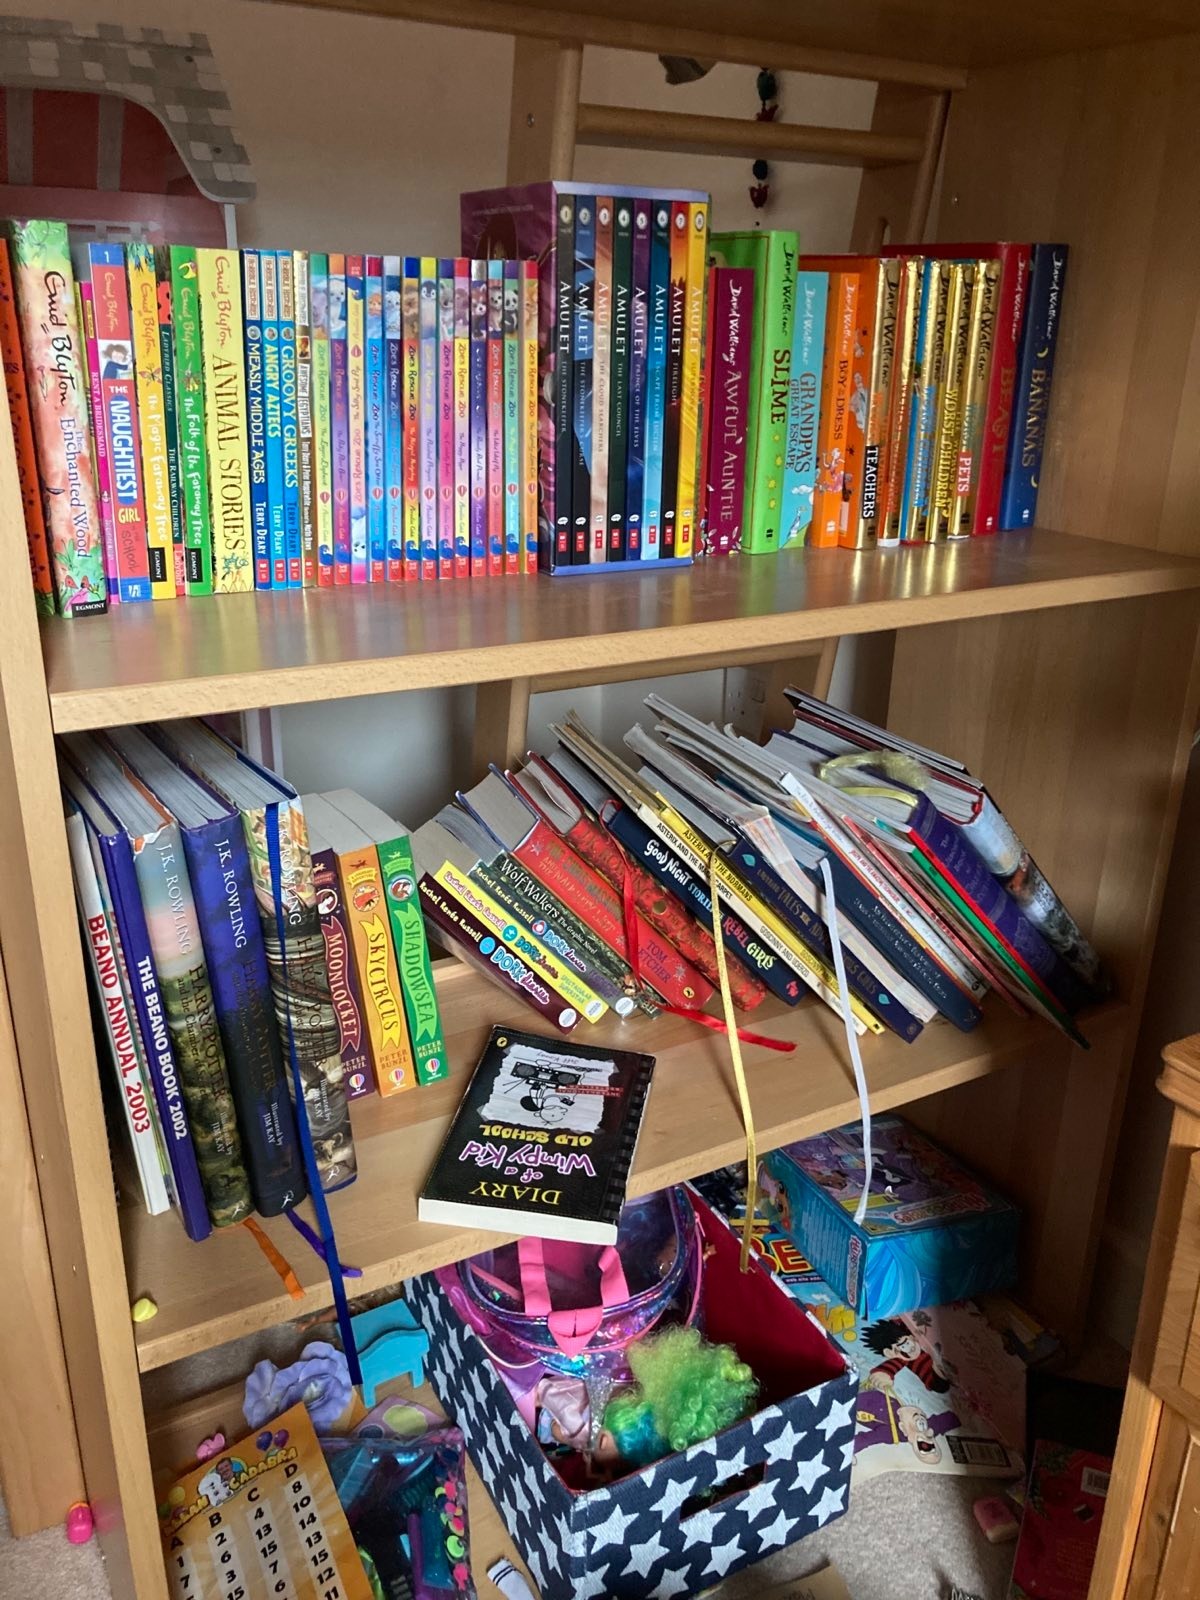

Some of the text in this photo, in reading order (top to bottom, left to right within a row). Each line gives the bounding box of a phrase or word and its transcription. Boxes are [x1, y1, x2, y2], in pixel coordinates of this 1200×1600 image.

[143, 317, 156, 356] Blyton
[216, 300, 232, 348] Blyton
[559, 281, 571, 354] AMULET
[577, 281, 589, 355] AMULET
[597, 282, 609, 354] AMULET
[615, 284, 628, 356] AMULET
[633, 286, 646, 357] AMULET
[653, 284, 666, 355] AMULET
[671, 286, 684, 356] AMULET
[689, 286, 702, 354] AMULET
[50, 334, 76, 406] Blyton
[108, 385, 128, 394] THE
[264, 344, 280, 438] ANGRY AZTECS
[91, 372, 106, 457] RENT BRIDESMAID
[248, 342, 264, 484] MEASLY MIDDLE AGES
[281, 345, 298, 489] GROOVY GREEKS
[298, 363, 311, 437] AWESOME EGYPTIANS
[785, 378, 801, 470] GREAT ESCAPE
[794, 372, 817, 474] GRANDPA'S
[833, 359, 849, 441] BOY DRESS
[942, 389, 957, 437] WORST
[1021, 367, 1047, 468] BANANAS
[110, 399, 137, 500] NAUGHTIEST
[187, 414, 201, 439] Folk
[212, 354, 246, 551] ANIMAL STORIES
[958, 455, 971, 493] PETS
[60, 417, 90, 558] Enchanted Wood
[148, 414, 168, 541] Magic Faraway Tree
[168, 447, 180, 539] THE RAILWAY CHILDREN
[863, 447, 878, 518] TEACHERS
[118, 508, 141, 524] GIRL
[191, 519, 205, 546] Tree
[255, 502, 267, 555] TERRY DEARY
[273, 505, 285, 555] TERRY DEARY
[287, 501, 299, 554] TERRY DEARY
[153, 551, 162, 578] EGMONT
[190, 552, 198, 578] EGMONT
[75, 602, 105, 612] EGMONT
[656, 822, 690, 854] ASTERIX AND
[278, 849, 302, 926] ROWLING
[681, 829, 754, 902] ASTERIX NORMANS
[155, 843, 194, 955] J.K. ROWLING
[214, 839, 247, 948] J.K. ROWLING
[418, 882, 483, 943] Rachel Renée Russell
[443, 871, 466, 894] Rachel
[482, 905, 507, 931] Russell
[477, 868, 535, 925] Rachel Renée Russell
[515, 937, 542, 962] DORK
[543, 930, 570, 957] DORK
[560, 916, 600, 956] The Graphic Novel
[645, 940, 668, 963] TOM
[722, 915, 778, 971] REBEL GIRLS
[780, 943, 795, 961] AND
[327, 931, 359, 1038] MOONLOCKET
[367, 933, 399, 1032] SKYCIRCUS
[401, 919, 435, 1024] SHADOWSEA
[490, 945, 527, 982] DORK
[88, 914, 119, 989] BEANO
[105, 995, 138, 1078] ANNUAL
[123, 1081, 151, 1133] 2003
[136, 955, 188, 1139] THE BEANO BOOK 2002
[186, 964, 228, 1103] HARRY POTTER
[459, 1141, 598, 1177] Wimpy Kid
[479, 1125, 593, 1147] OLD SCHOOL
[468, 1181, 562, 1206] DIARY
[504, 1167, 544, 1184] of a
[248, 1488, 260, 1502] C
[285, 1464, 298, 1478] D
[292, 1481, 302, 1494] 8
[209, 1513, 222, 1528] B
[255, 1508, 264, 1520] 4
[293, 1496, 311, 1513] 10
[299, 1513, 317, 1530] 14
[215, 1533, 227, 1547] 2
[255, 1524, 273, 1540] 13
[260, 1541, 278, 1559] 15
[305, 1532, 323, 1549] 13
[177, 1556, 185, 1568] 1
[220, 1551, 232, 1564] 6
[226, 1570, 237, 1584] 3
[269, 1560, 279, 1575] 7
[311, 1549, 329, 1567] 15
[317, 1567, 336, 1585] 12
[180, 1575, 190, 1589] 7
[275, 1580, 286, 1593] 6
[325, 1587, 339, 1600] 11
